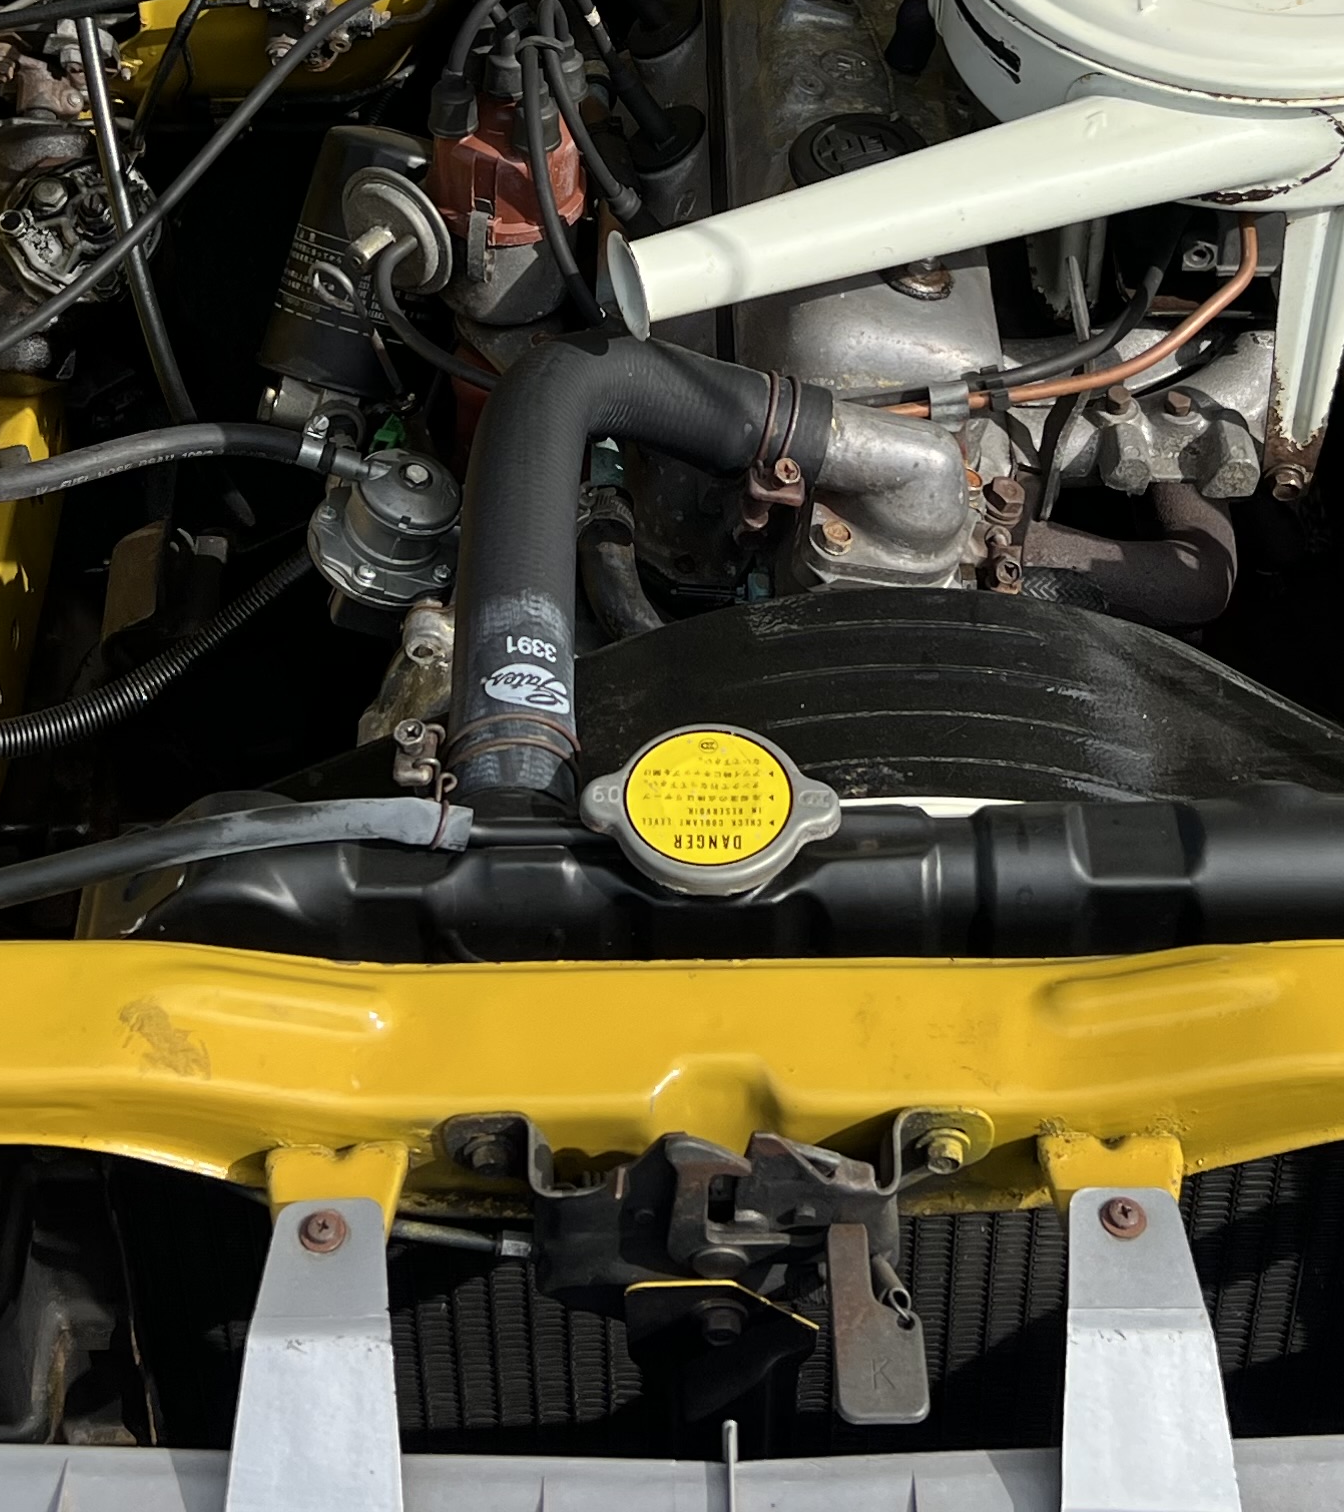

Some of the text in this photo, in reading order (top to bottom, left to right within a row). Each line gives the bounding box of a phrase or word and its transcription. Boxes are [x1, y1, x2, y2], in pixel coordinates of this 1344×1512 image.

[506, 635, 557, 664] 3391
[485, 671, 569, 707] Gates
[750, 807, 762, 815] IN
[641, 816, 762, 827] CHECK COOLANT LEVEL
[673, 834, 742, 850] DANGER
